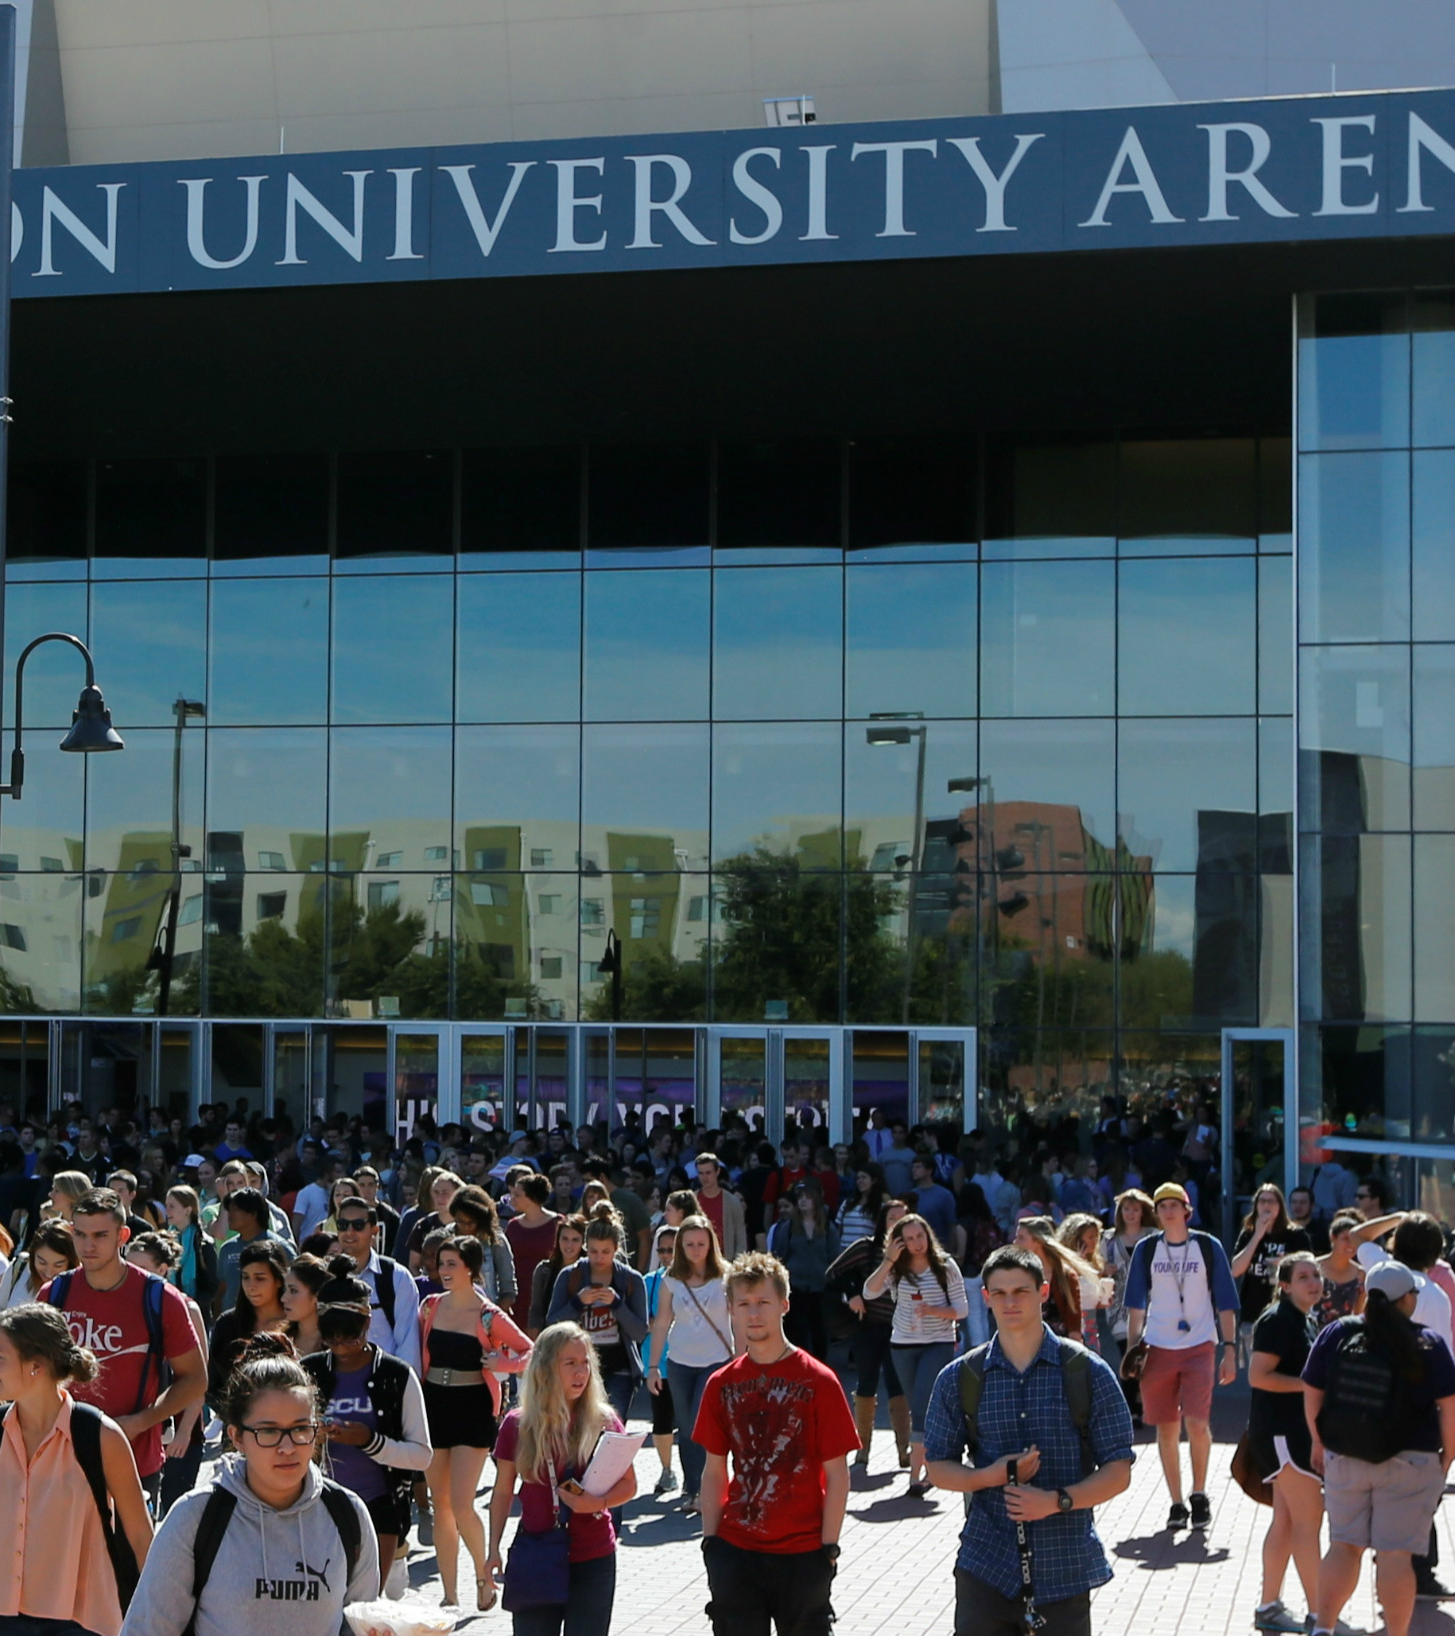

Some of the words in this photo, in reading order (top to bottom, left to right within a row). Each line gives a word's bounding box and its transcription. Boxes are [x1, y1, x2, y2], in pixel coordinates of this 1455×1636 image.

[177, 132, 1045, 270] UNIVERSITY
[1078, 110, 1455, 228] AREN
[254, 1577, 320, 1601] PUMA
